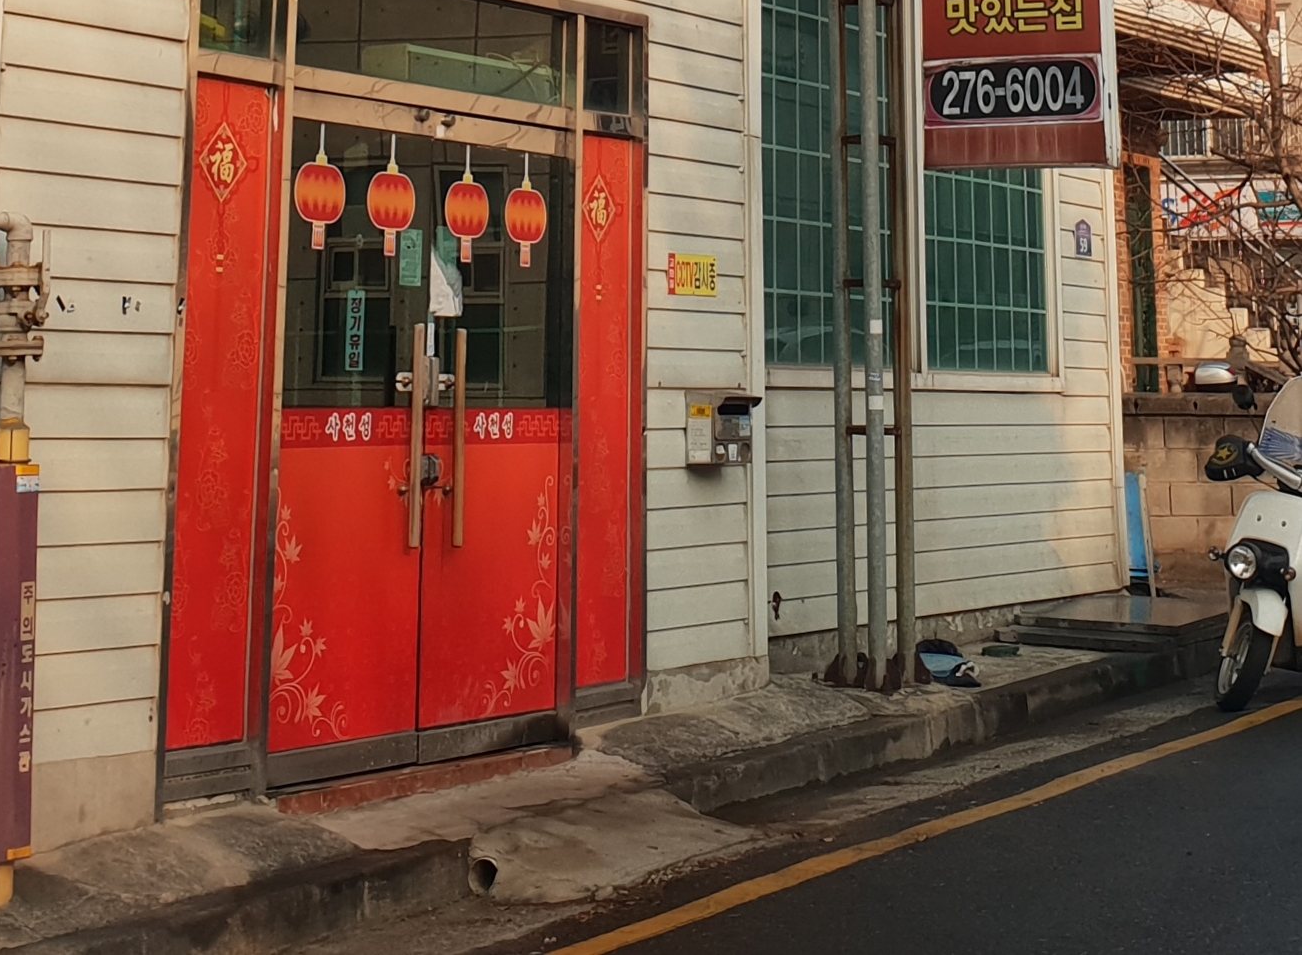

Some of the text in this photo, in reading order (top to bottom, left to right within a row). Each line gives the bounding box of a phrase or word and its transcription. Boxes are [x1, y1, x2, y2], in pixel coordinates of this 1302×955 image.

[942, 65, 1086, 115] 276-6004
[208, 140, 235, 185] 福
[590, 189, 608, 227] 福
[1079, 237, 1088, 253] 59
[348, 297, 363, 368] 정기휴일
[325, 412, 373, 442] 사천성
[473, 412, 514, 440] 사천성
[22, 584, 33, 635] 주의
